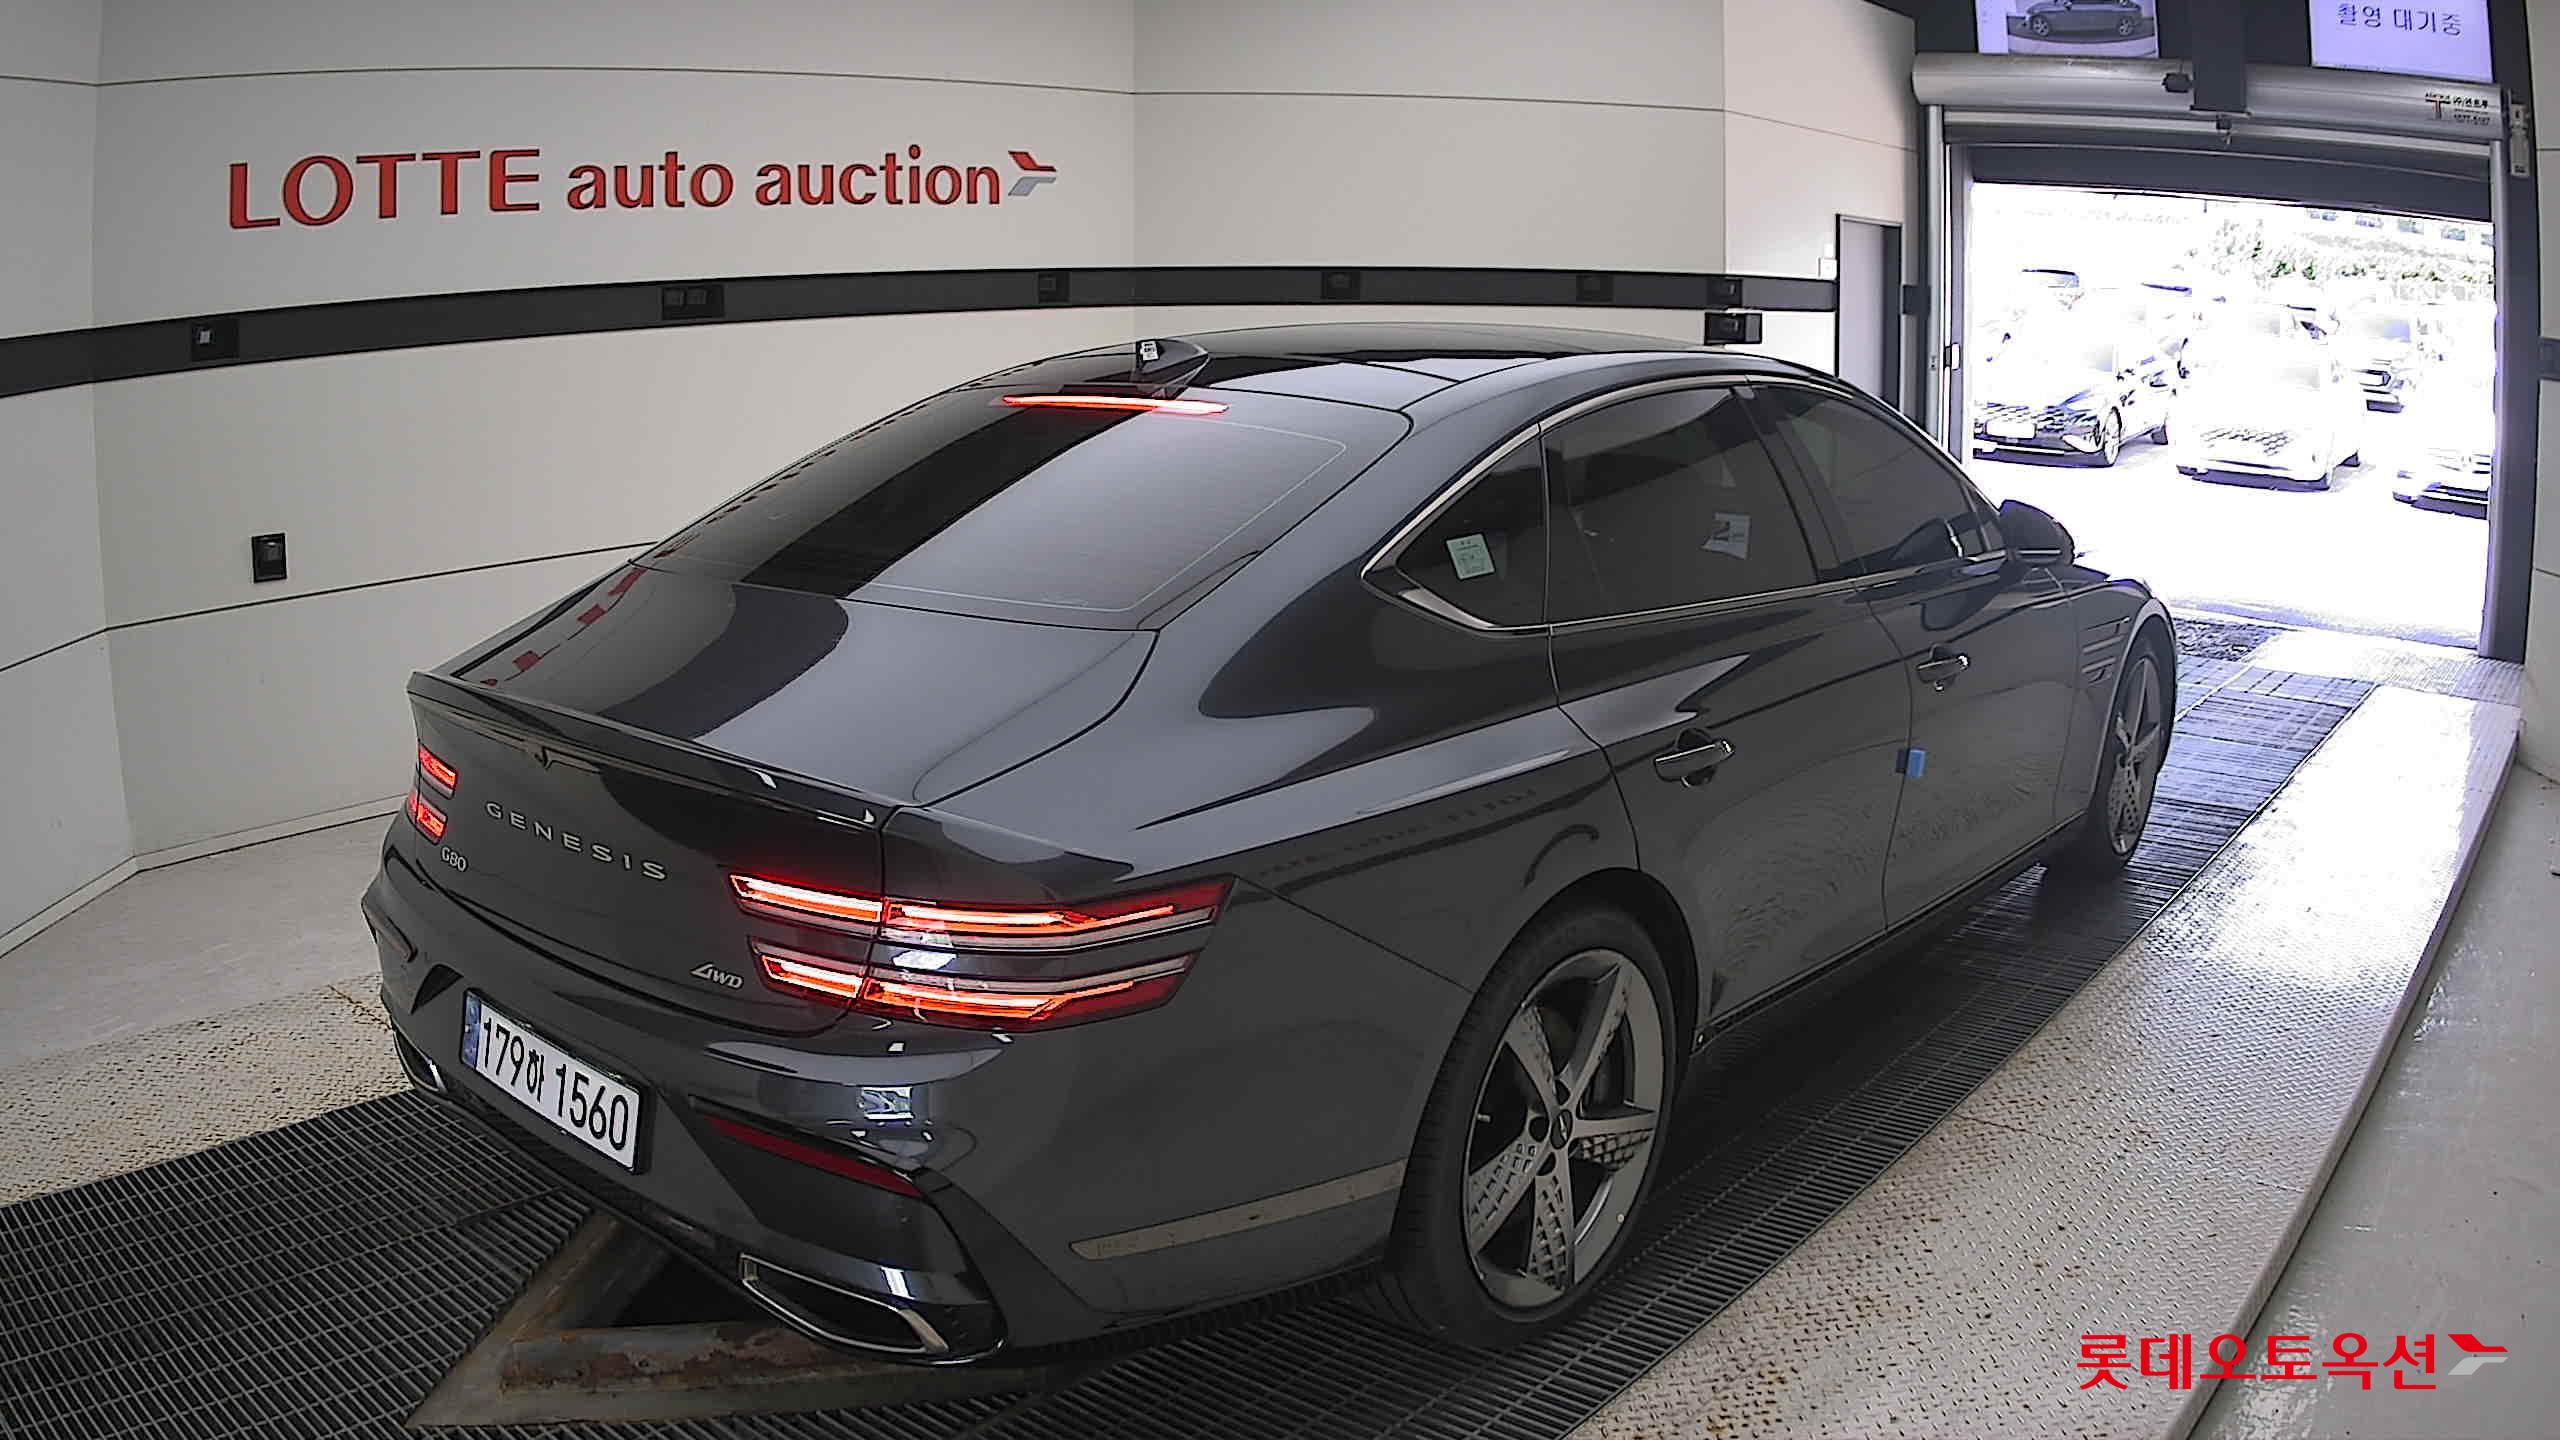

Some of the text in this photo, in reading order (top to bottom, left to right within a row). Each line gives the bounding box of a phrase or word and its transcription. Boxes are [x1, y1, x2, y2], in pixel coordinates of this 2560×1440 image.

[2393, 8, 2461, 36] 대기중
[229, 144, 1001, 230] LOTTE auto auction
[441, 846, 467, 872] G80
[485, 801, 667, 881] GENESIS
[690, 962, 744, 990] 4WD
[483, 1017, 629, 1151] 179하 1560
